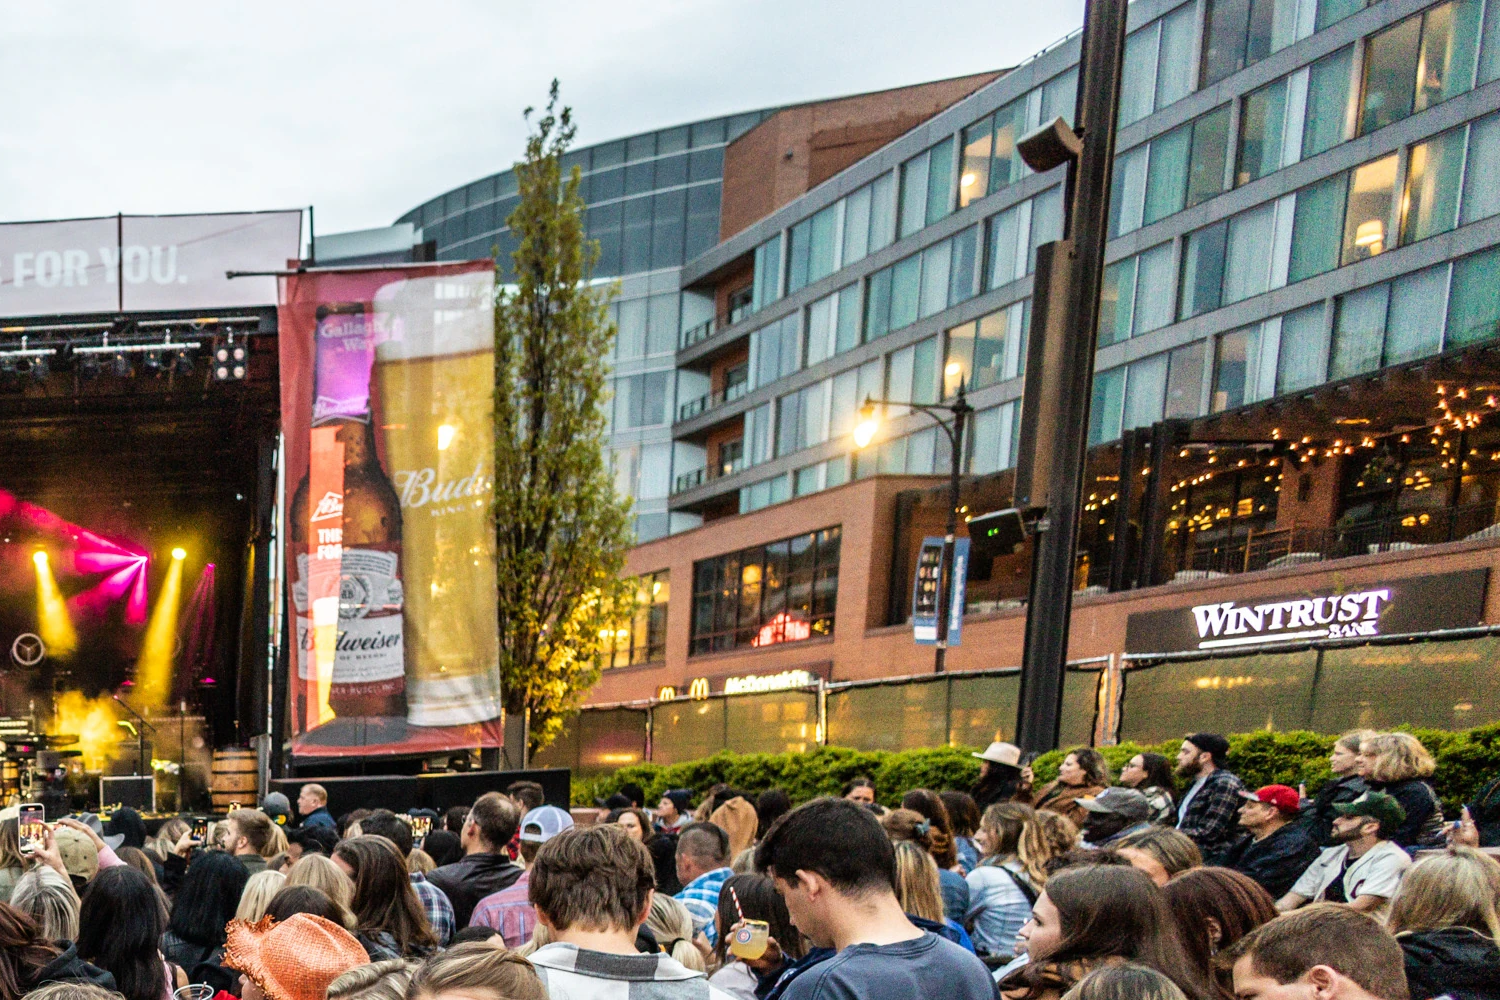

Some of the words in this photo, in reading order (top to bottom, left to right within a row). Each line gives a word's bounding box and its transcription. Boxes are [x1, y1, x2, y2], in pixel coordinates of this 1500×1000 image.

[13, 248, 91, 288] FOR
[99, 244, 189, 285] YOU.
[1191, 589, 1391, 638] WINTRUST
[1328, 620, 1379, 638] BANK
